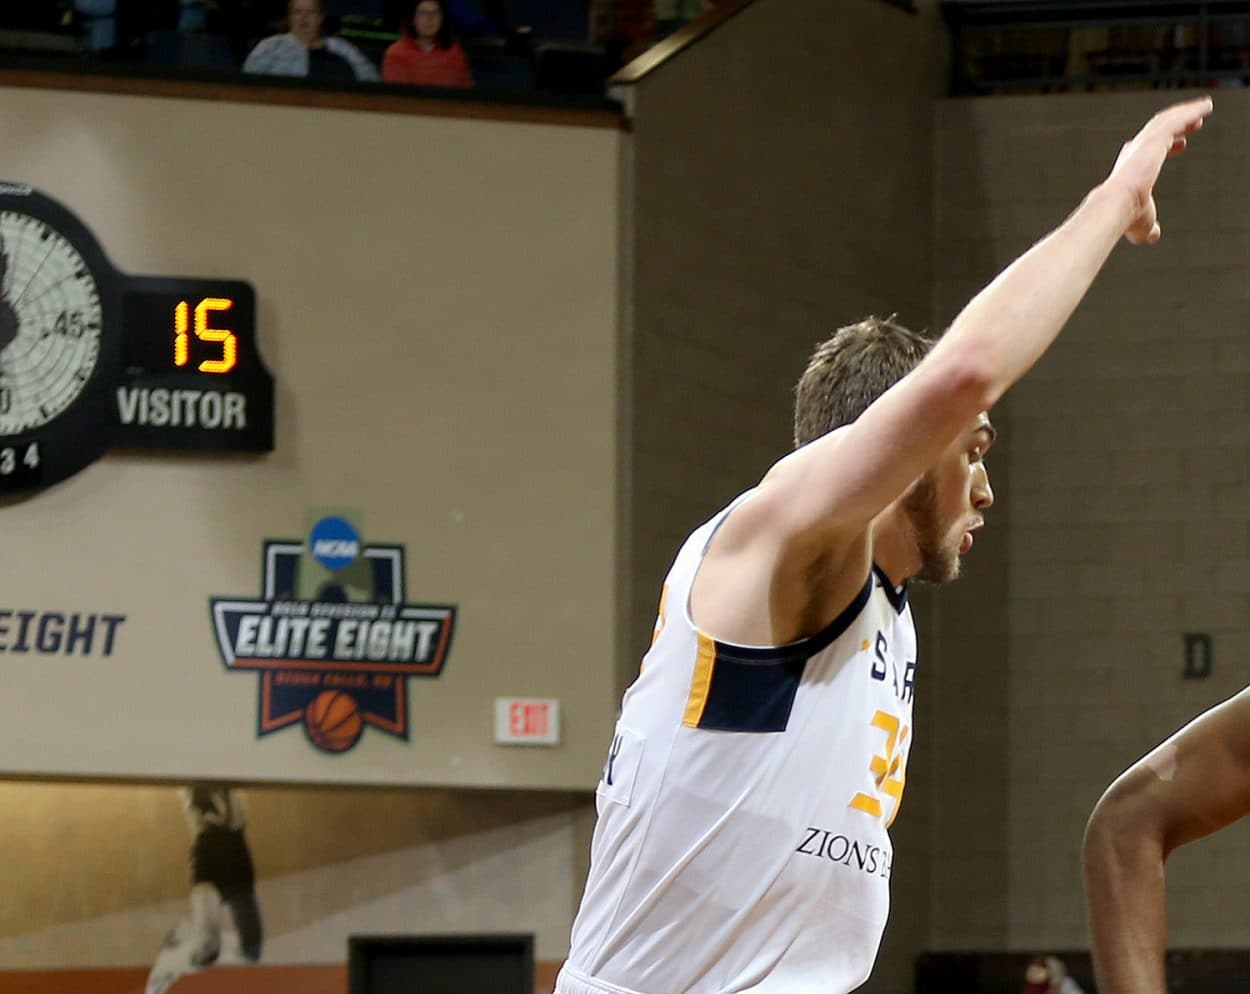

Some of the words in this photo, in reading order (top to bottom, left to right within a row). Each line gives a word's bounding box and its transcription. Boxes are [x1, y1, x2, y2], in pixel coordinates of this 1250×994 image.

[174, 297, 237, 373] 15
[117, 385, 246, 430] VISITOR
[235, 615, 332, 658] ELITE
[333, 620, 438, 662] EIGHT
[1183, 632, 1213, 680] D
[511, 702, 550, 736] EXIT
[796, 827, 880, 874] ZIONS
